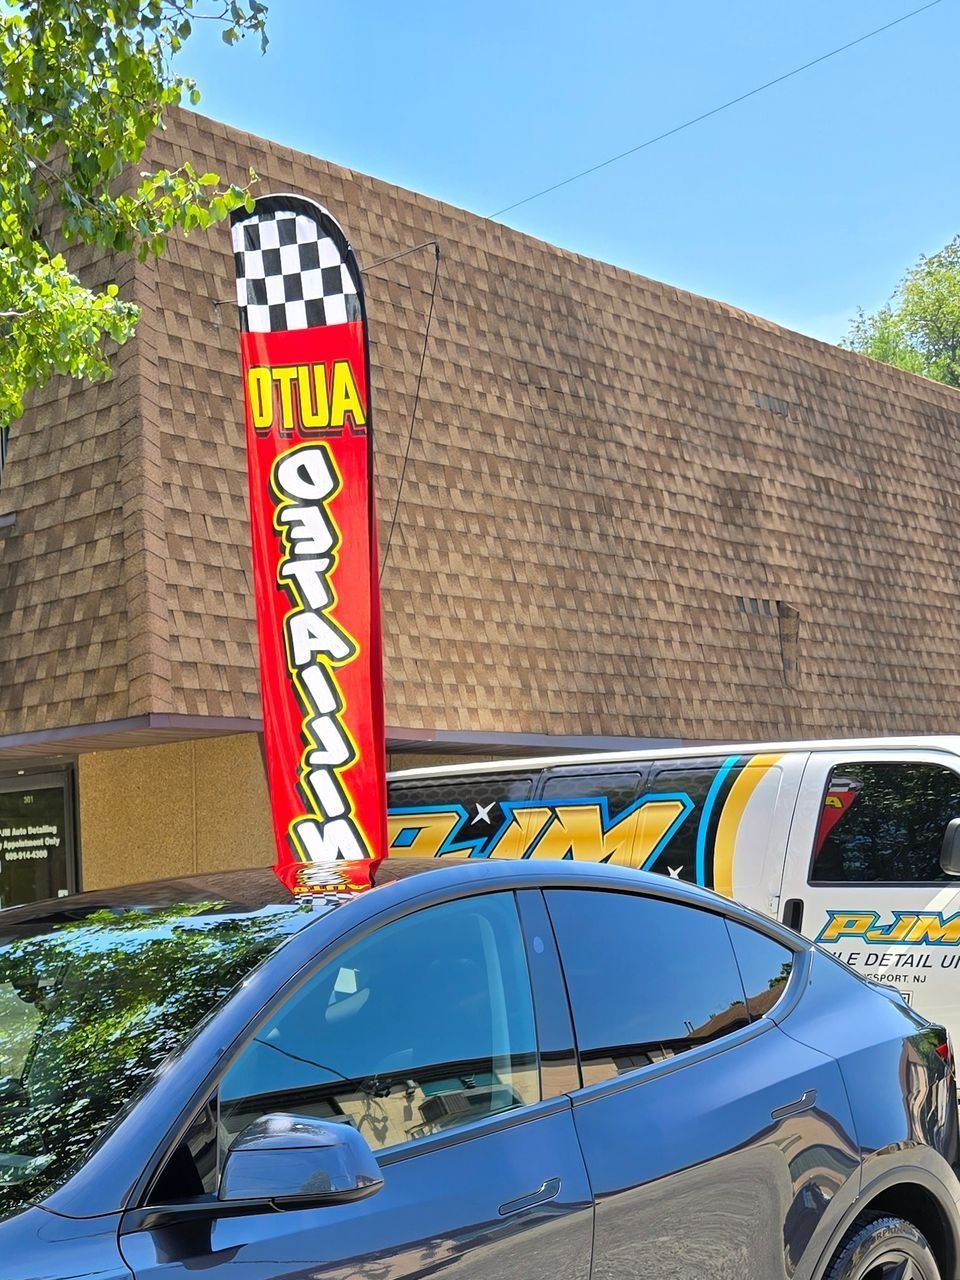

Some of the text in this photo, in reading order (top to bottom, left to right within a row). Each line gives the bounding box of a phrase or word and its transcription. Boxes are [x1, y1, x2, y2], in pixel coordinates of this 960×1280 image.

[12, 827, 27, 836] Auto
[28, 825, 58, 835] Detailing
[3, 838, 44, 850] Appointment
[45, 836, 60, 847] Only
[815, 910, 960, 946] PJM
[864, 952, 932, 968] DETAIL
[913, 974, 927, 984] NJ
